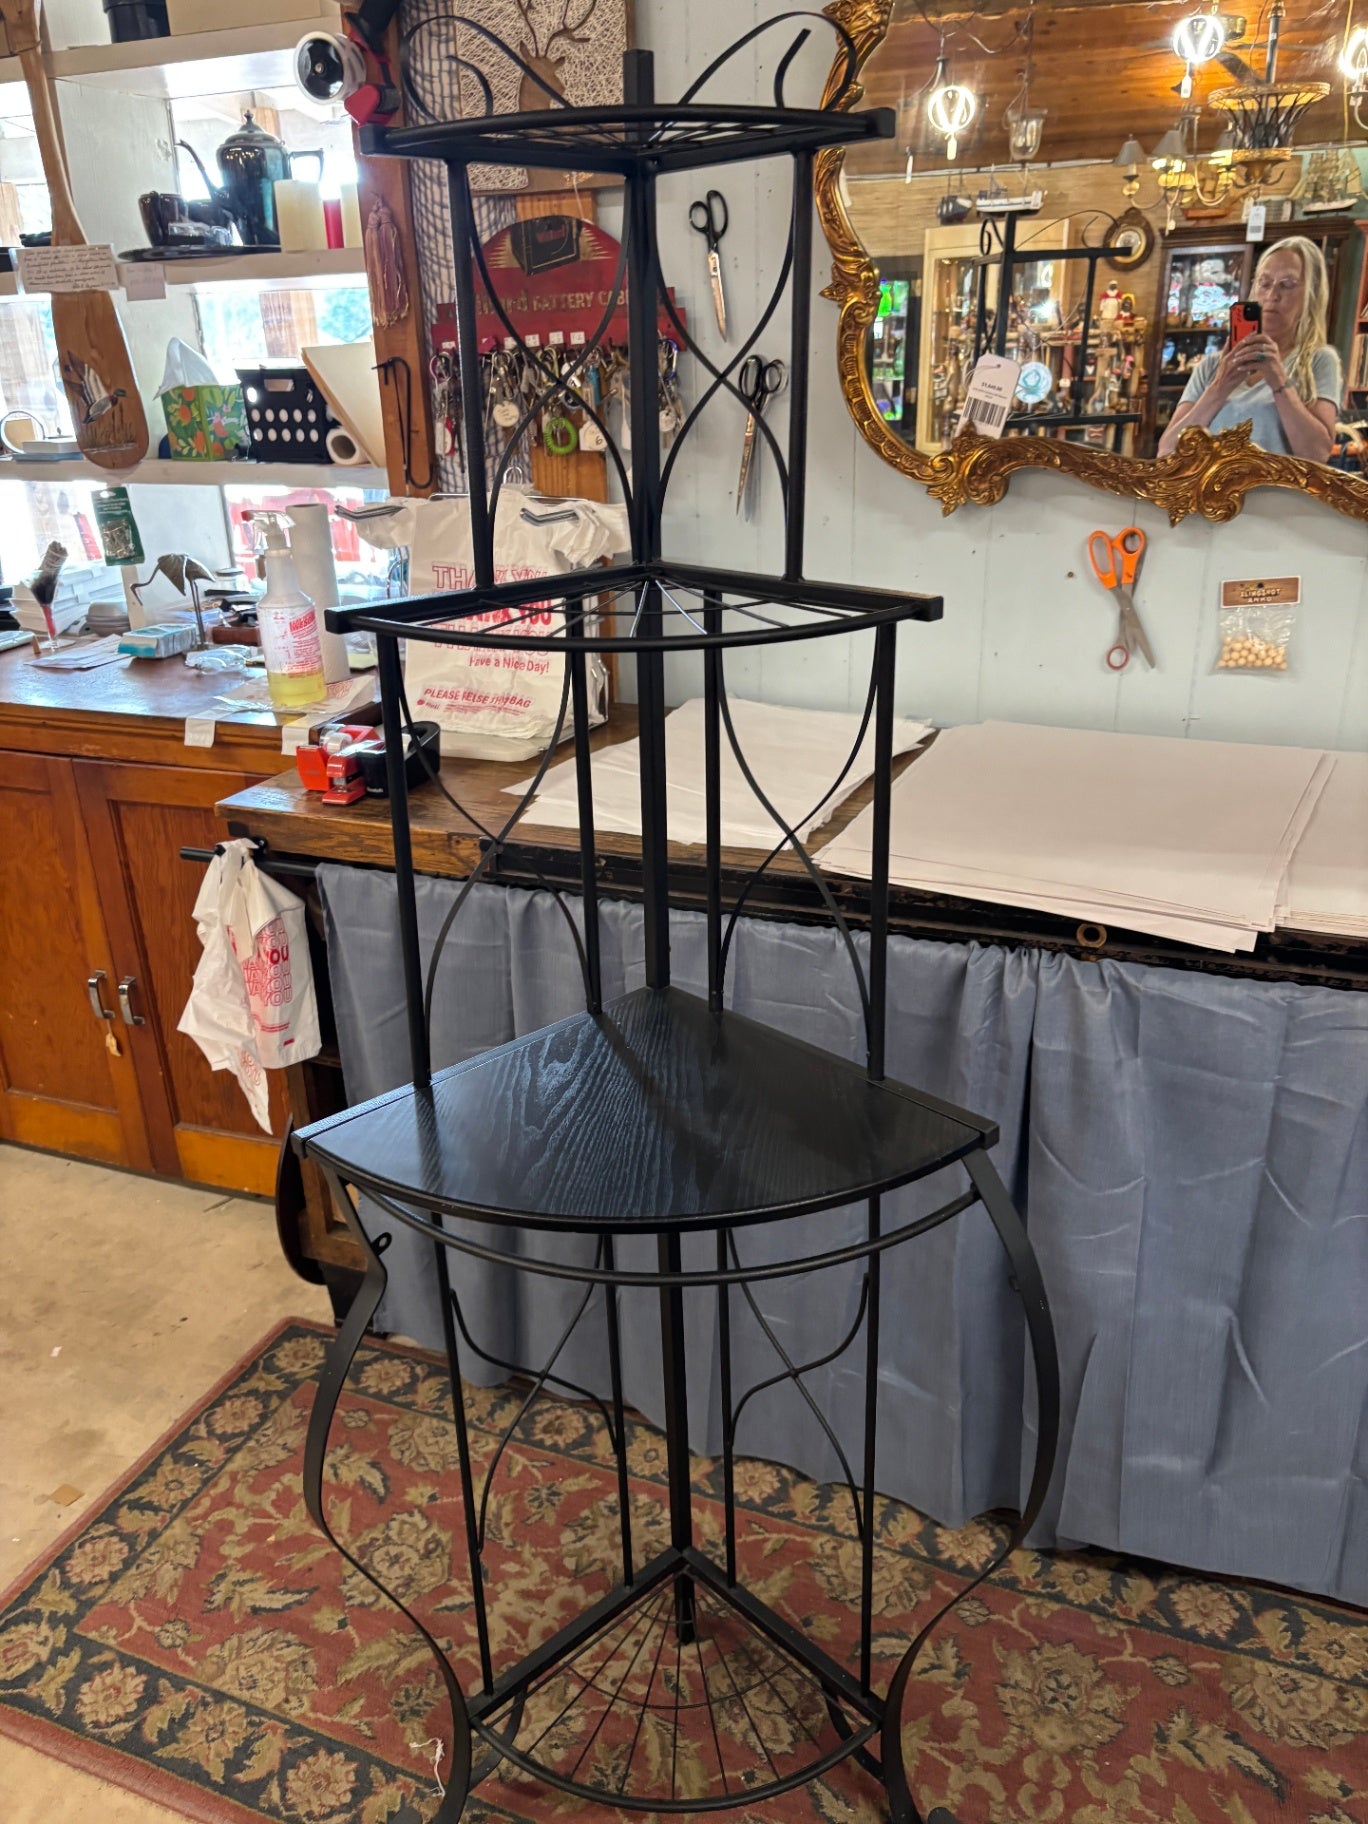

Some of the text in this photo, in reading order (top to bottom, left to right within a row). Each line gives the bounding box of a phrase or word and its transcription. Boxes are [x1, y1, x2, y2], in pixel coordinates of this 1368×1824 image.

[494, 658, 500, 667] a
[502, 657, 525, 671] Nice
[526, 660, 550, 675] Day!
[423, 688, 460, 700] PLEASE
[509, 695, 531, 708] BAG
